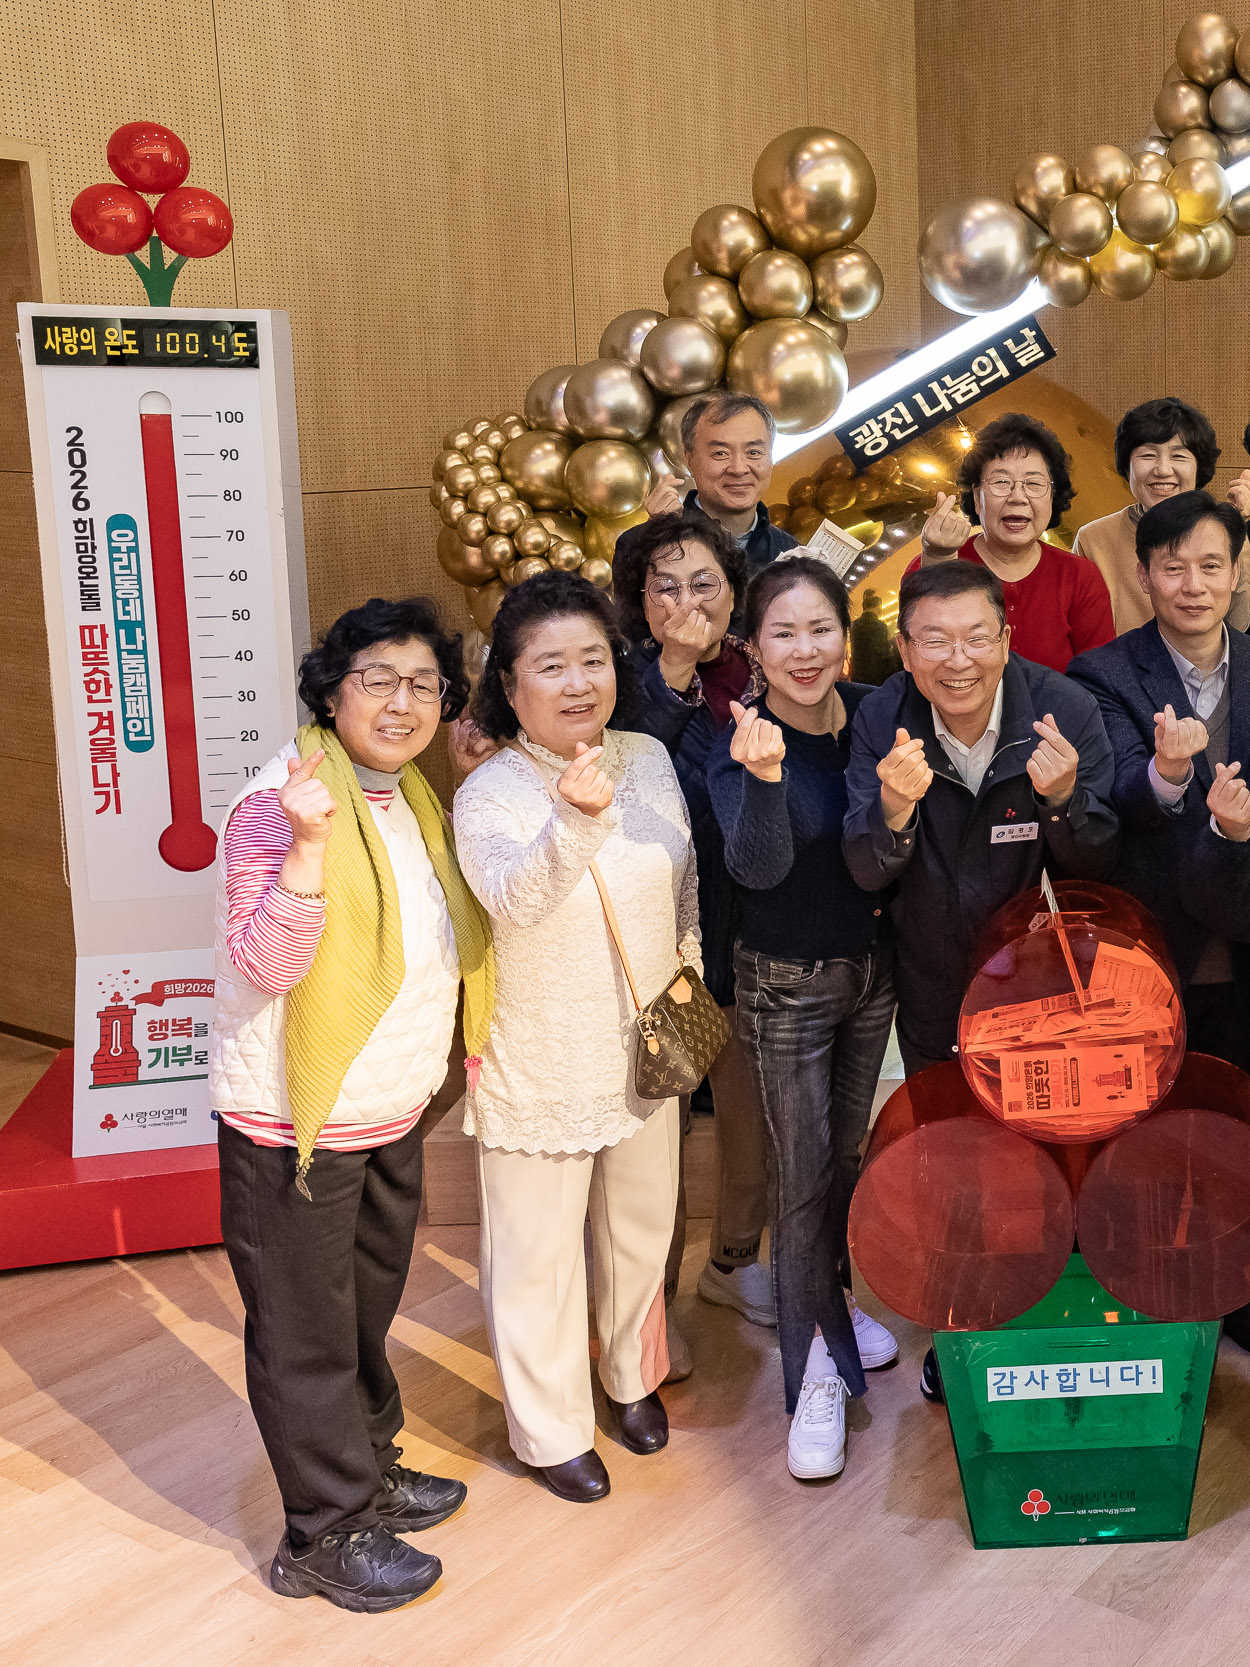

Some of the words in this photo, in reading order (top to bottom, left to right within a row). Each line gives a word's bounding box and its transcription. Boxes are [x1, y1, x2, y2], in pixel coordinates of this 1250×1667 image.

[45, 326, 97, 356] 사랑의
[104, 327, 139, 356] 온도
[848, 401, 919, 457] 광진
[912, 347, 1010, 418] 나눔의
[1003, 326, 1045, 368] 날
[215, 411, 244, 424] 100
[219, 449, 239, 461] 90
[65, 426, 91, 512] 2026
[223, 489, 242, 502] 80
[226, 530, 245, 542] 70
[72, 517, 101, 612] 희망온돌
[110, 528, 143, 622] 우리동네
[228, 569, 248, 582] 60
[231, 609, 250, 621] 50
[79, 624, 113, 704] 따뜻한
[234, 650, 253, 662] 40
[118, 627, 152, 742] 나눔캠페인
[237, 690, 256, 702] 30
[240, 730, 259, 742] 20
[87, 711, 122, 815] 겨울나기
[243, 766, 261, 778] 10
[164, 983, 215, 995] 희망2026
[147, 1017, 208, 1041] 행복을
[147, 1045, 208, 1069] 기부로
[1033, 1059, 1051, 1111] 따뜻한
[121, 1107, 188, 1124] 사랑의열매
[992, 1363, 1158, 1396] 감사합니다!
